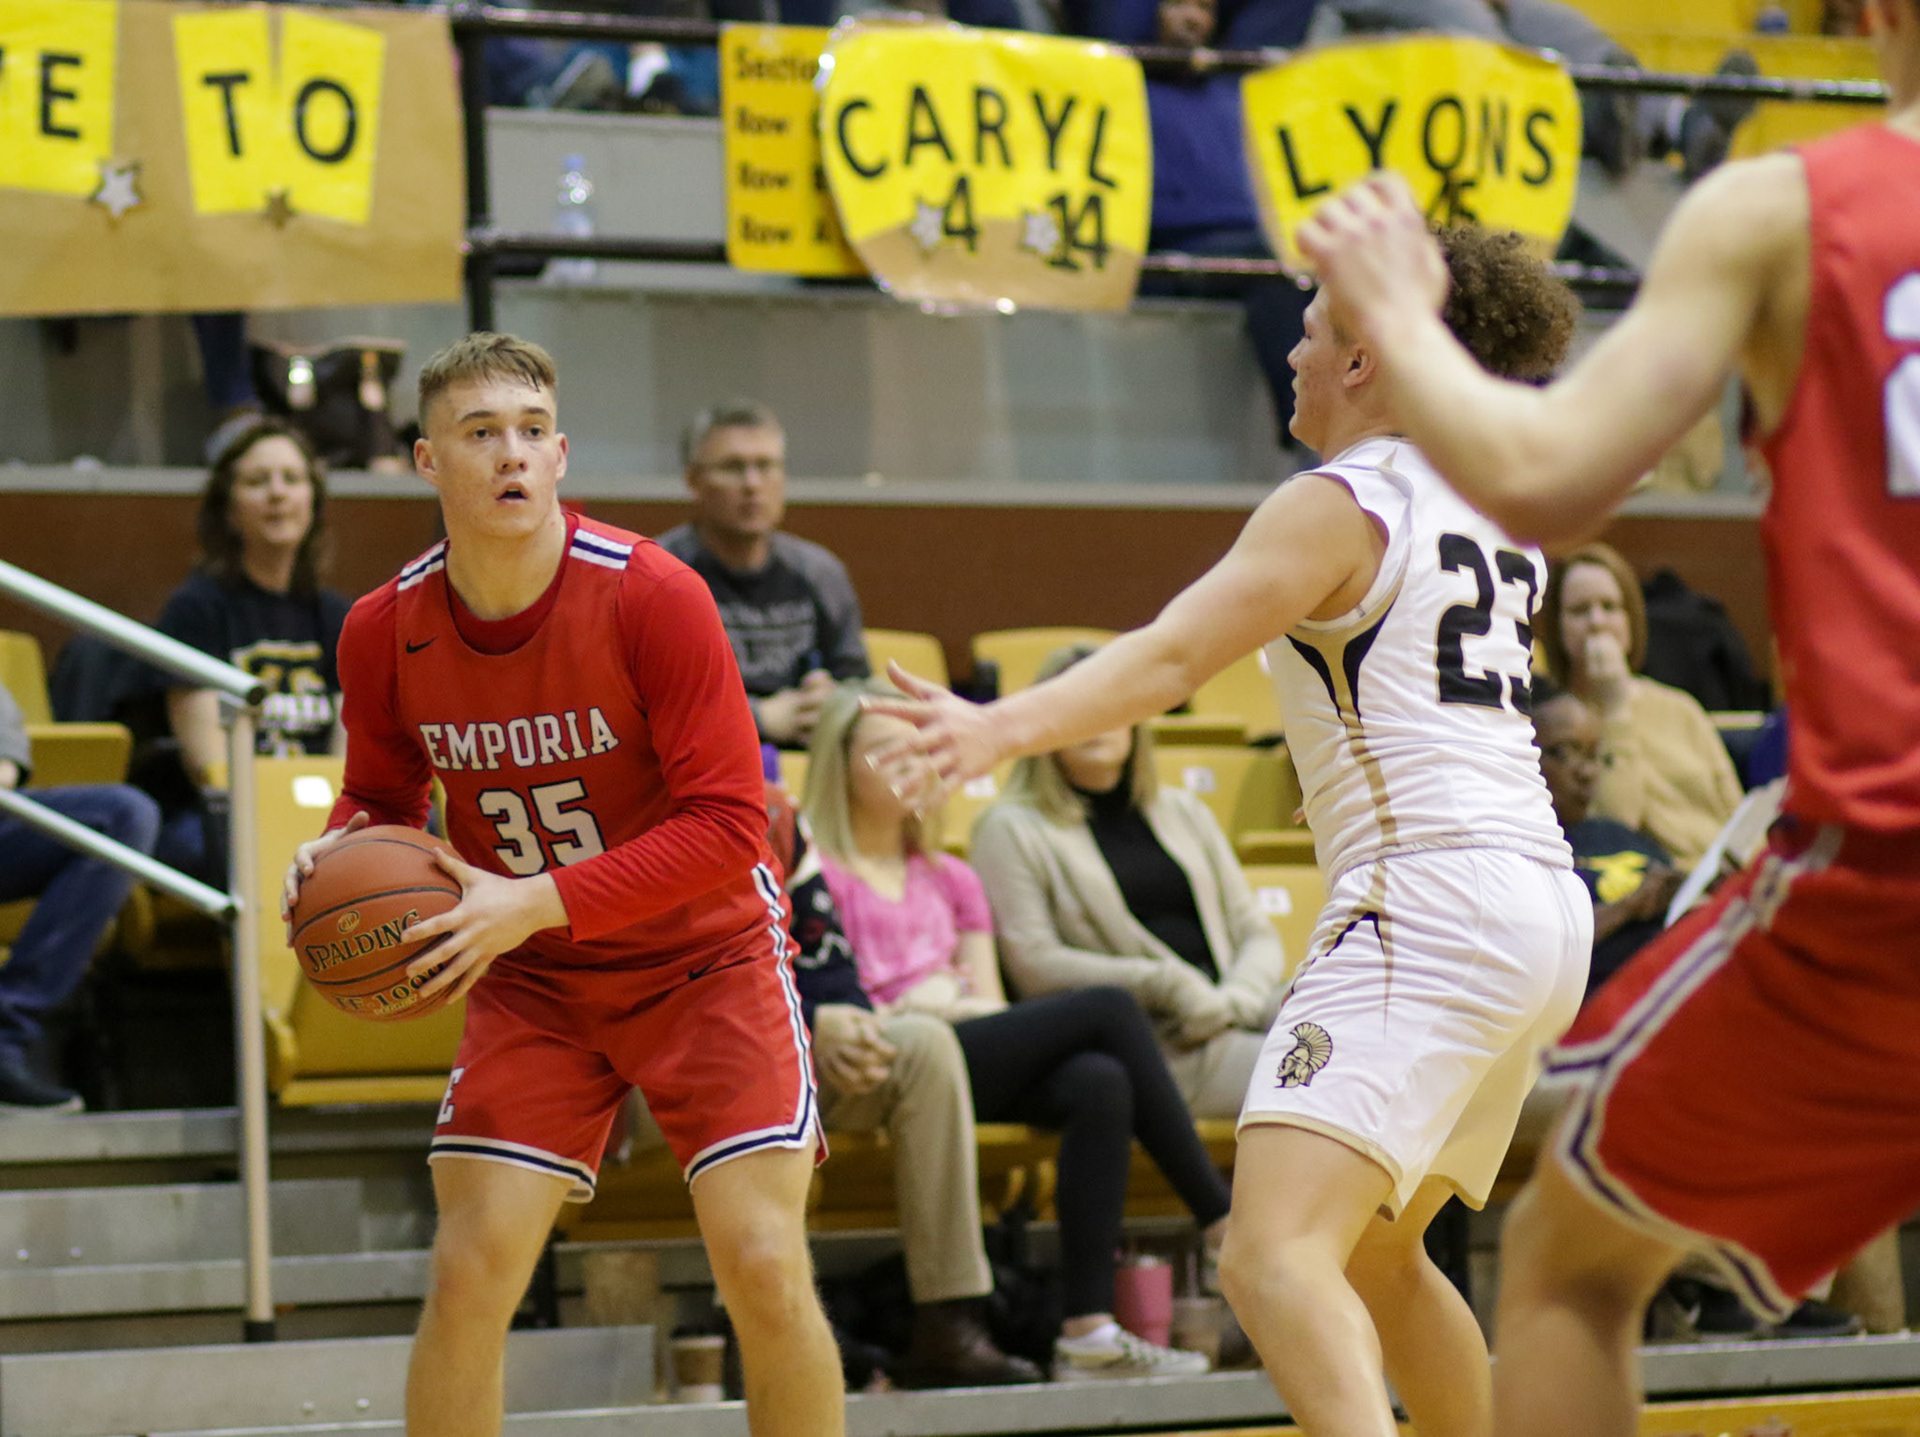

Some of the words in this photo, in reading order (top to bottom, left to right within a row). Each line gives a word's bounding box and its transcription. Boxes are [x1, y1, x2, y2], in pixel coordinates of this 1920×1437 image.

[0, 46, 82, 139] E
[203, 72, 358, 164] TO
[735, 47, 822, 80] Sectio
[837, 83, 1120, 188] CARYL
[1275, 93, 1556, 200] LYONS
[943, 176, 978, 252] 4
[1048, 193, 1112, 270] 14
[1436, 531, 1538, 715] 23
[419, 706, 621, 771] EMPORIA
[476, 777, 607, 877] 35
